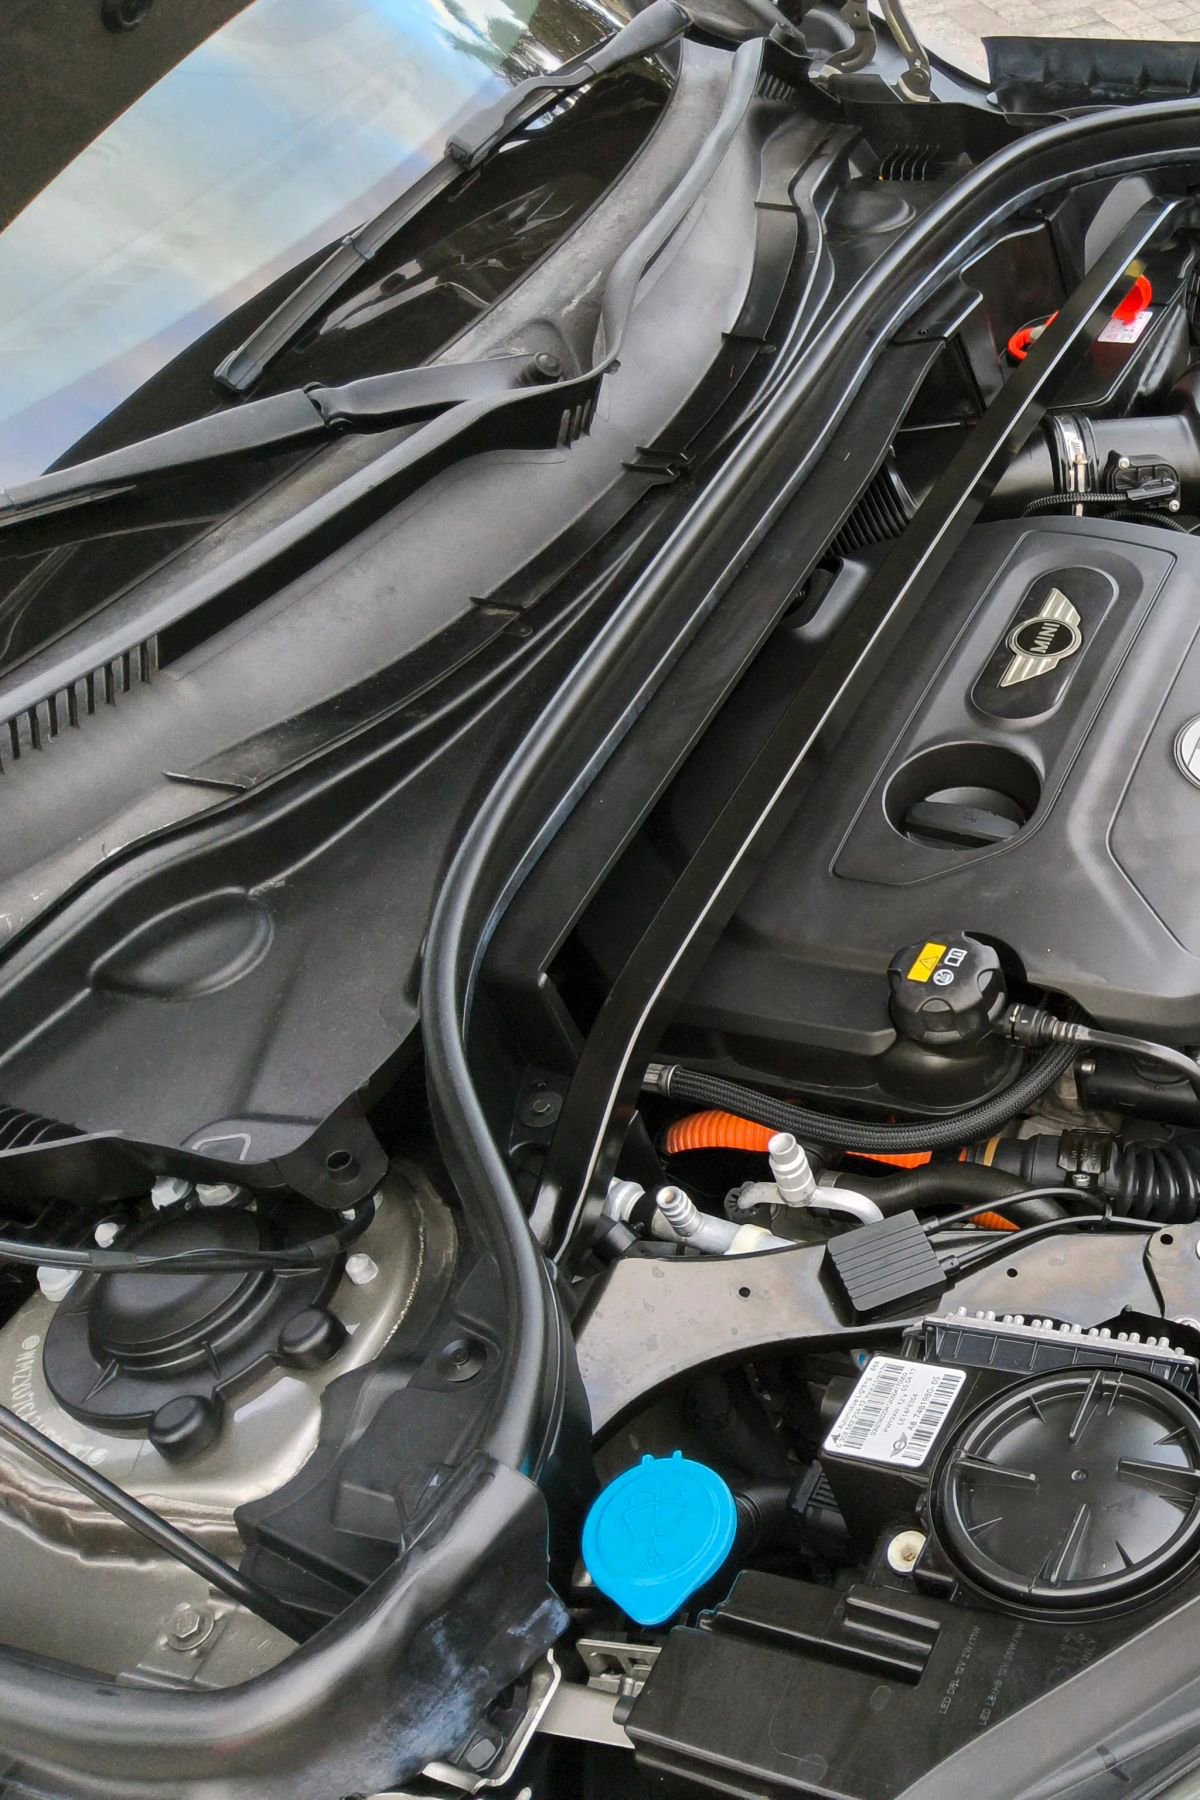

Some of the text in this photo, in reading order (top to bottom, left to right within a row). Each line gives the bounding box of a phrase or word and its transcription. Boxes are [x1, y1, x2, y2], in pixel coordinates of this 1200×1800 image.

[1030, 622, 1060, 653] MINI
[939, 1697, 951, 1714] LED
[978, 1707, 991, 1726] LED
